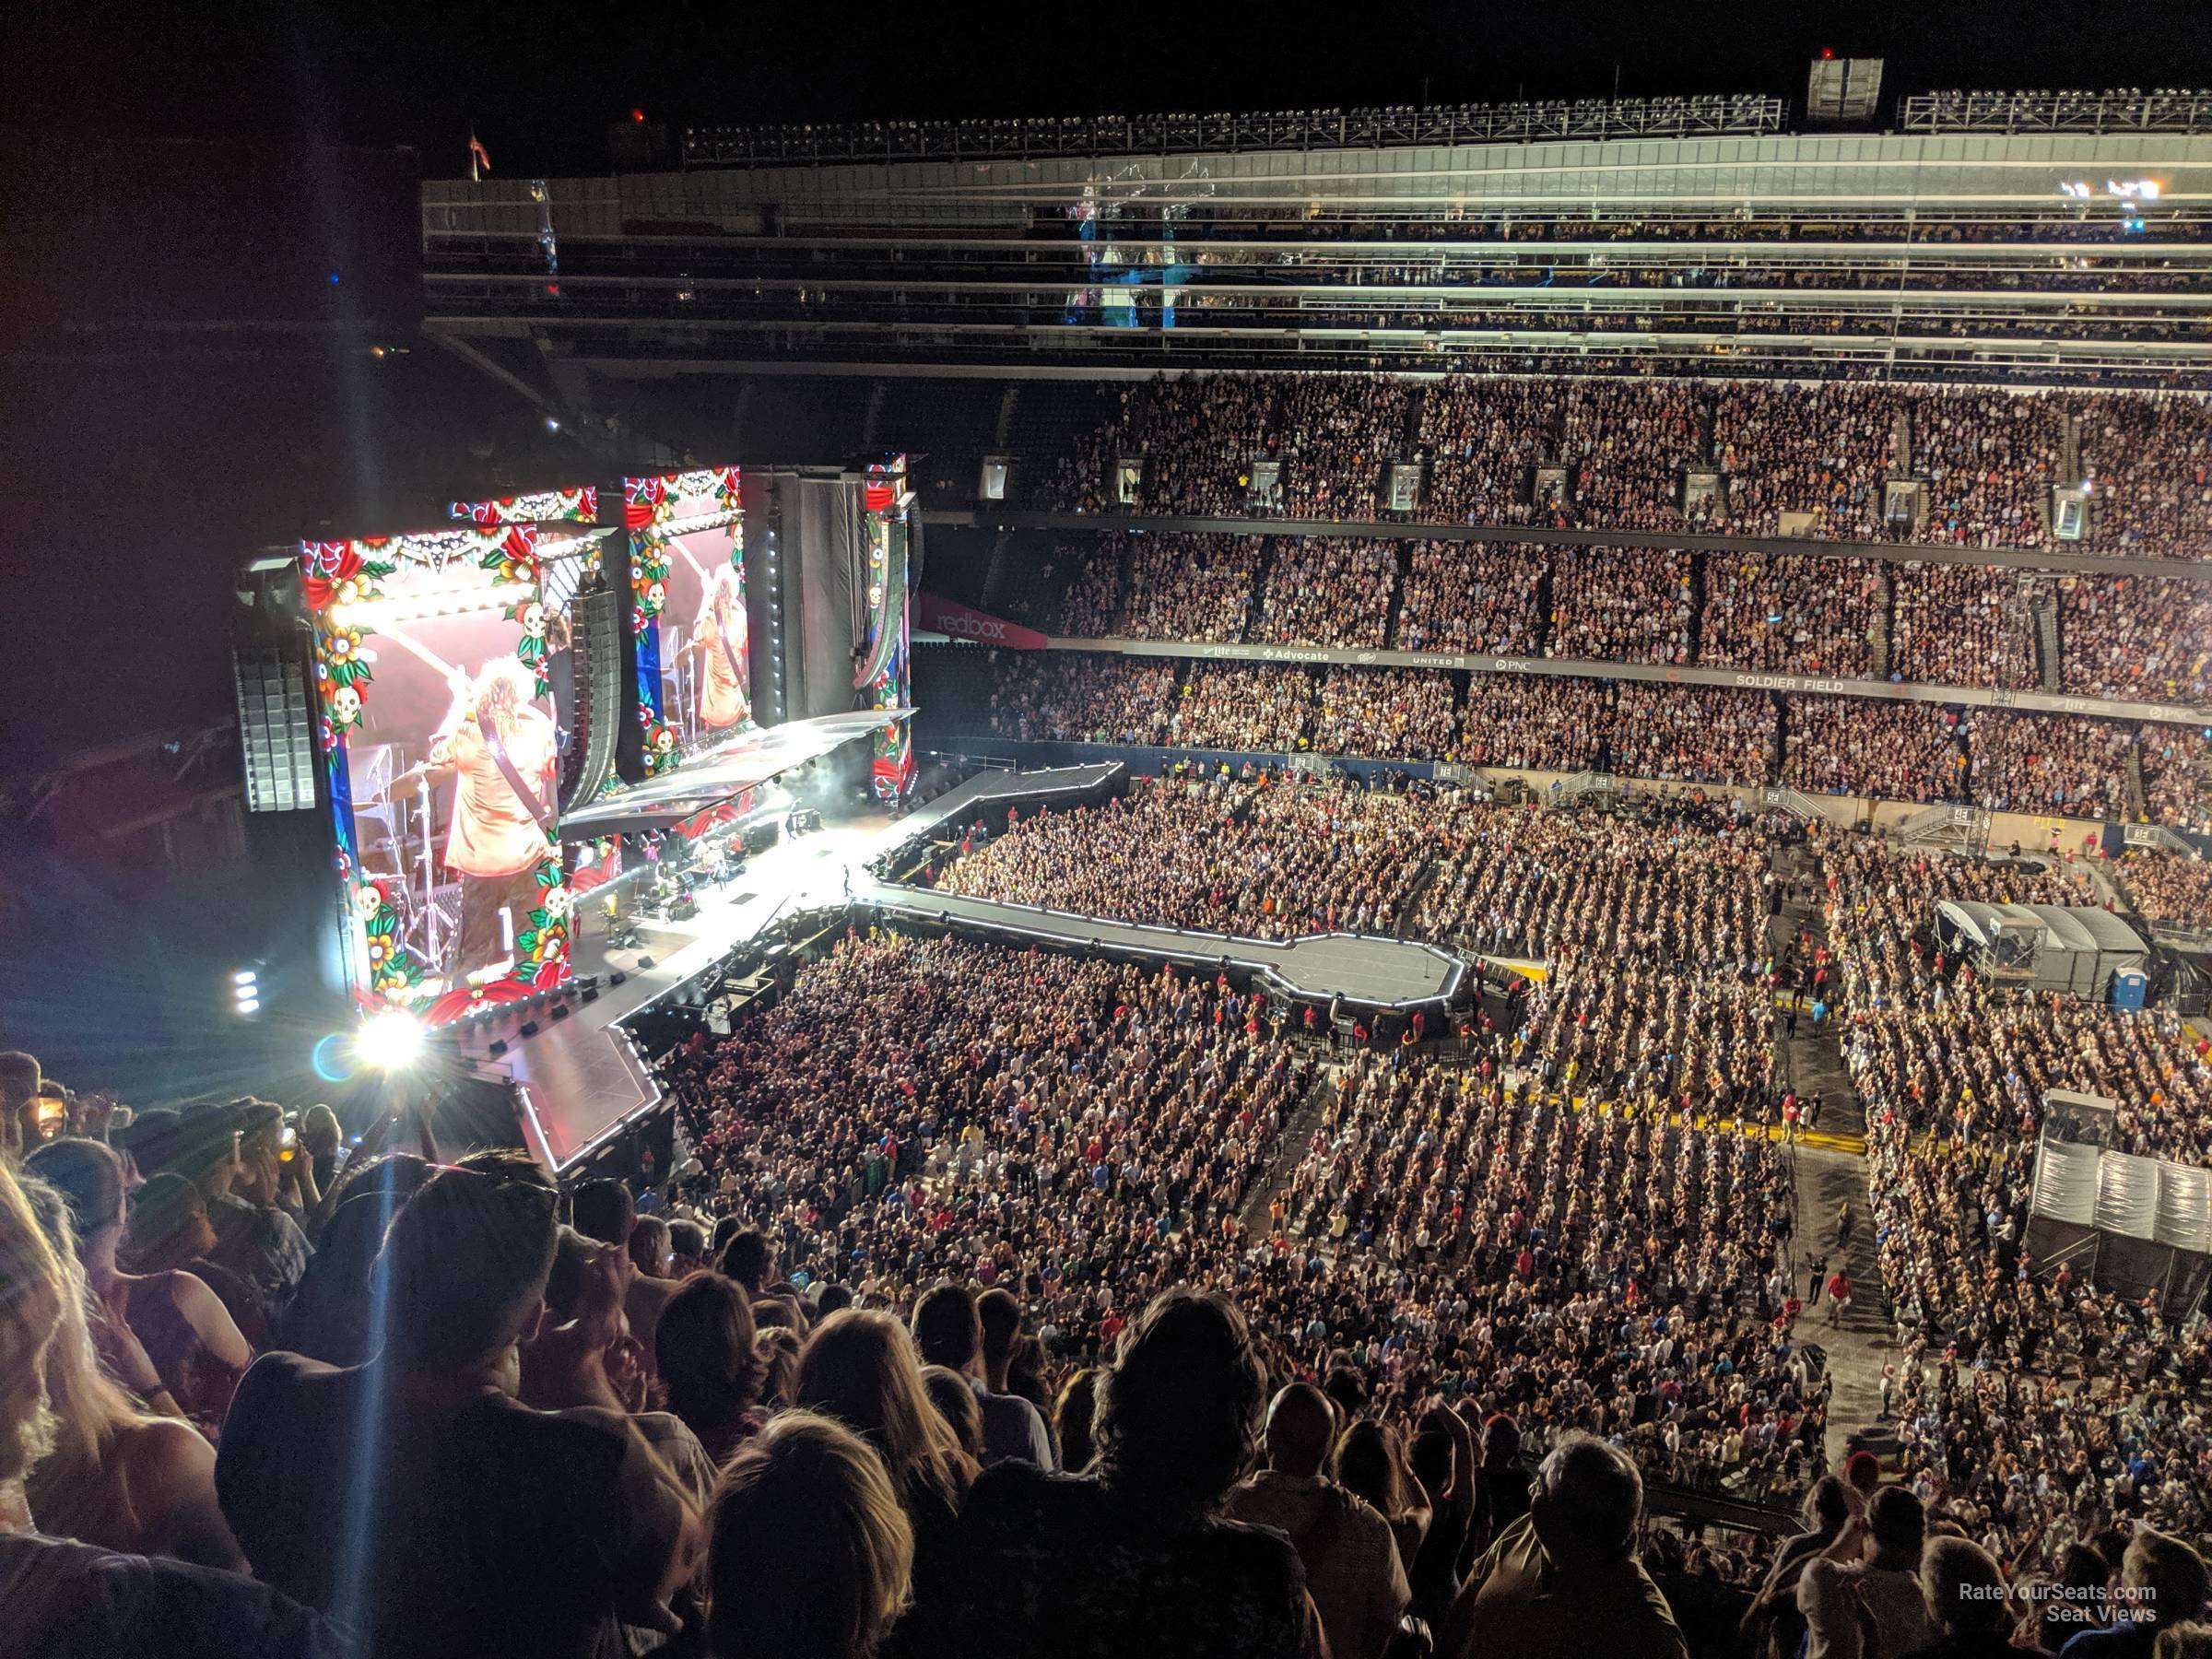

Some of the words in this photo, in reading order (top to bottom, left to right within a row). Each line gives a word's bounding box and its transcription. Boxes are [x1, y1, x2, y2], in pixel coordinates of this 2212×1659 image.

[937, 612, 1006, 639] redbox
[1276, 650, 1329, 661] Advocate
[1413, 657, 1453, 665] UNITED
[1508, 660, 1531, 671] PNC
[1736, 675, 1795, 689] SOLDIER
[1804, 679, 1843, 692] FIELD
[2164, 711, 2193, 720] PNC
